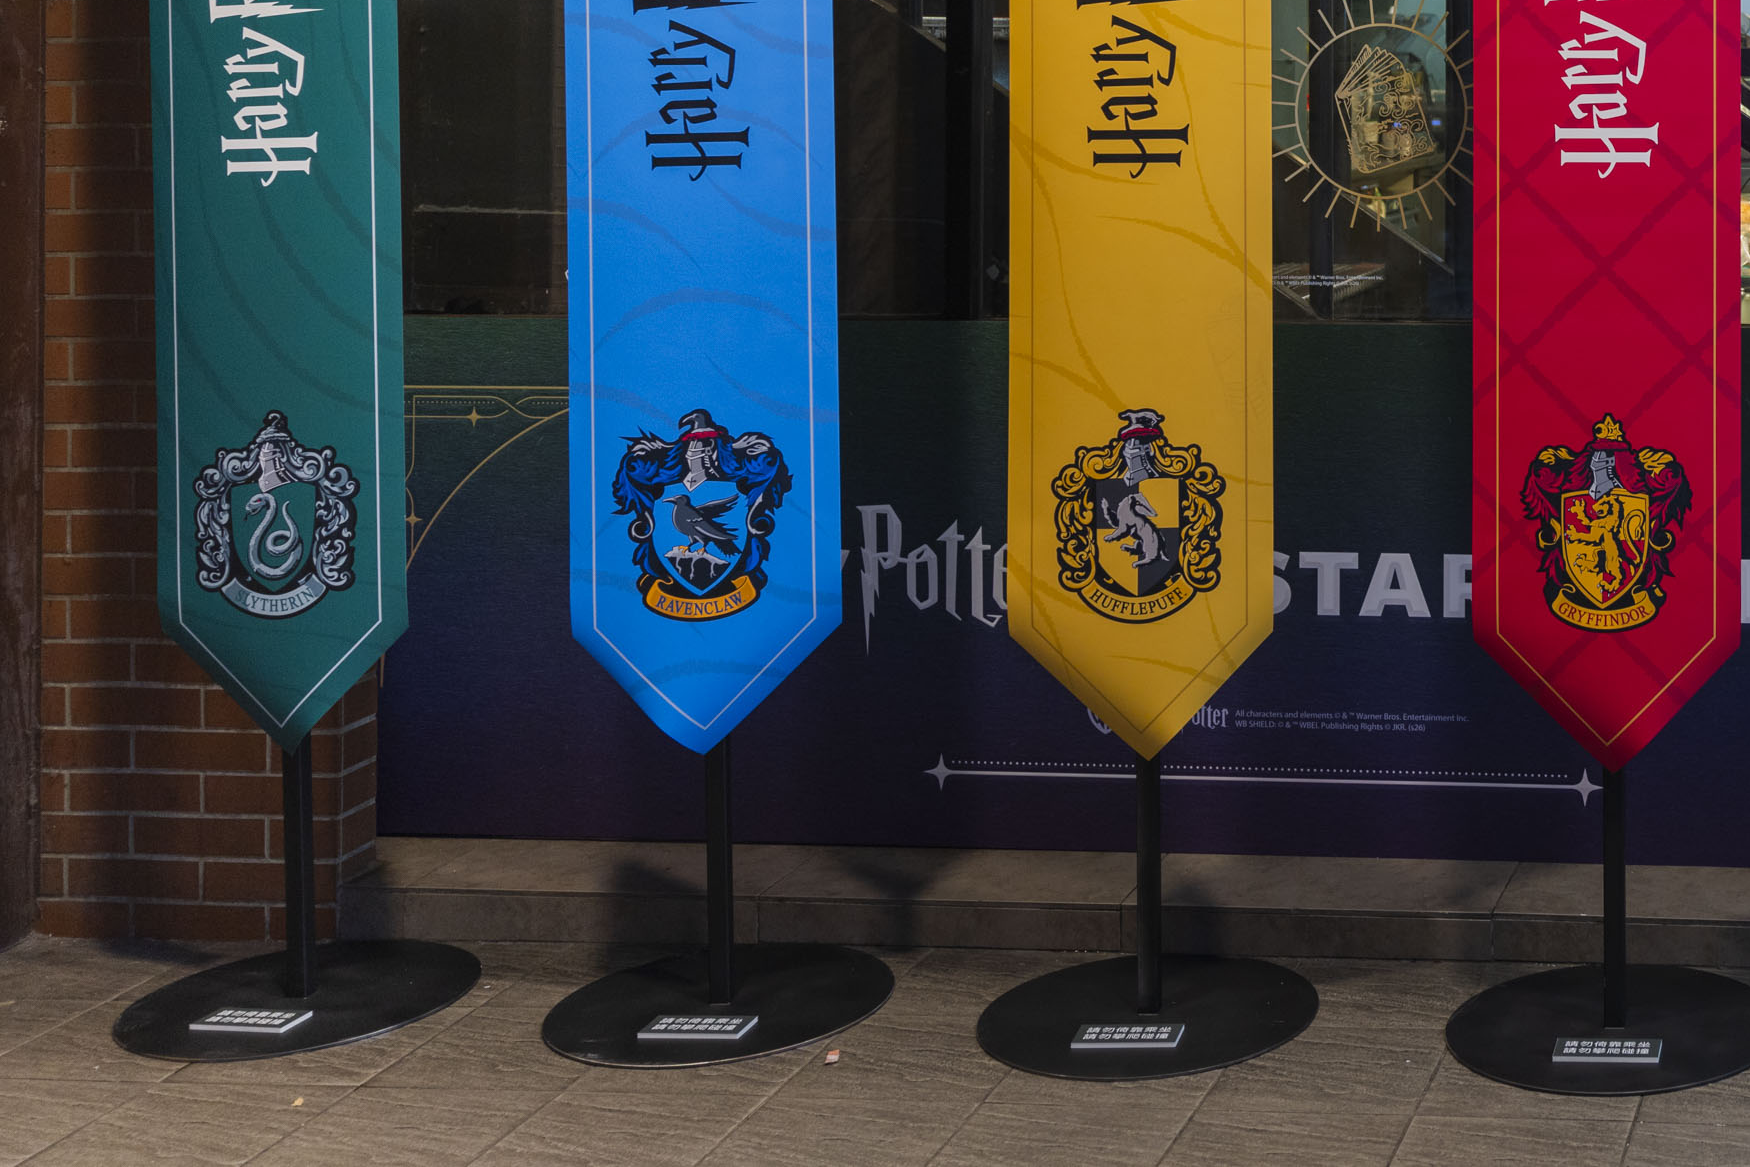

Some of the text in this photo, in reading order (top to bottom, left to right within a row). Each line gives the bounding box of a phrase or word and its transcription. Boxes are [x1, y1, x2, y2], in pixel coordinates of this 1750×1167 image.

[220, 26, 319, 188] Harry
[644, 19, 751, 182] Harry
[1086, 15, 1190, 180] Harry
[1554, 10, 1660, 180] Harry
[234, 588, 316, 615] SLYTHERIN
[655, 591, 745, 617] RAVENCLAW
[1090, 585, 1187, 616] HUFFLEPUFF
[1558, 602, 1650, 627] GRYFFINDOR
[1192, 707, 1229, 729] otter
[1235, 710, 1245, 718] All
[1246, 710, 1282, 718] characters
[1284, 710, 1298, 719] and
[1300, 711, 1333, 719] elements
[1356, 712, 1382, 720] Warner
[1403, 713, 1455, 721] Entertainment
[1321, 722, 1358, 732] Publishing
[1360, 723, 1383, 732] Rights
